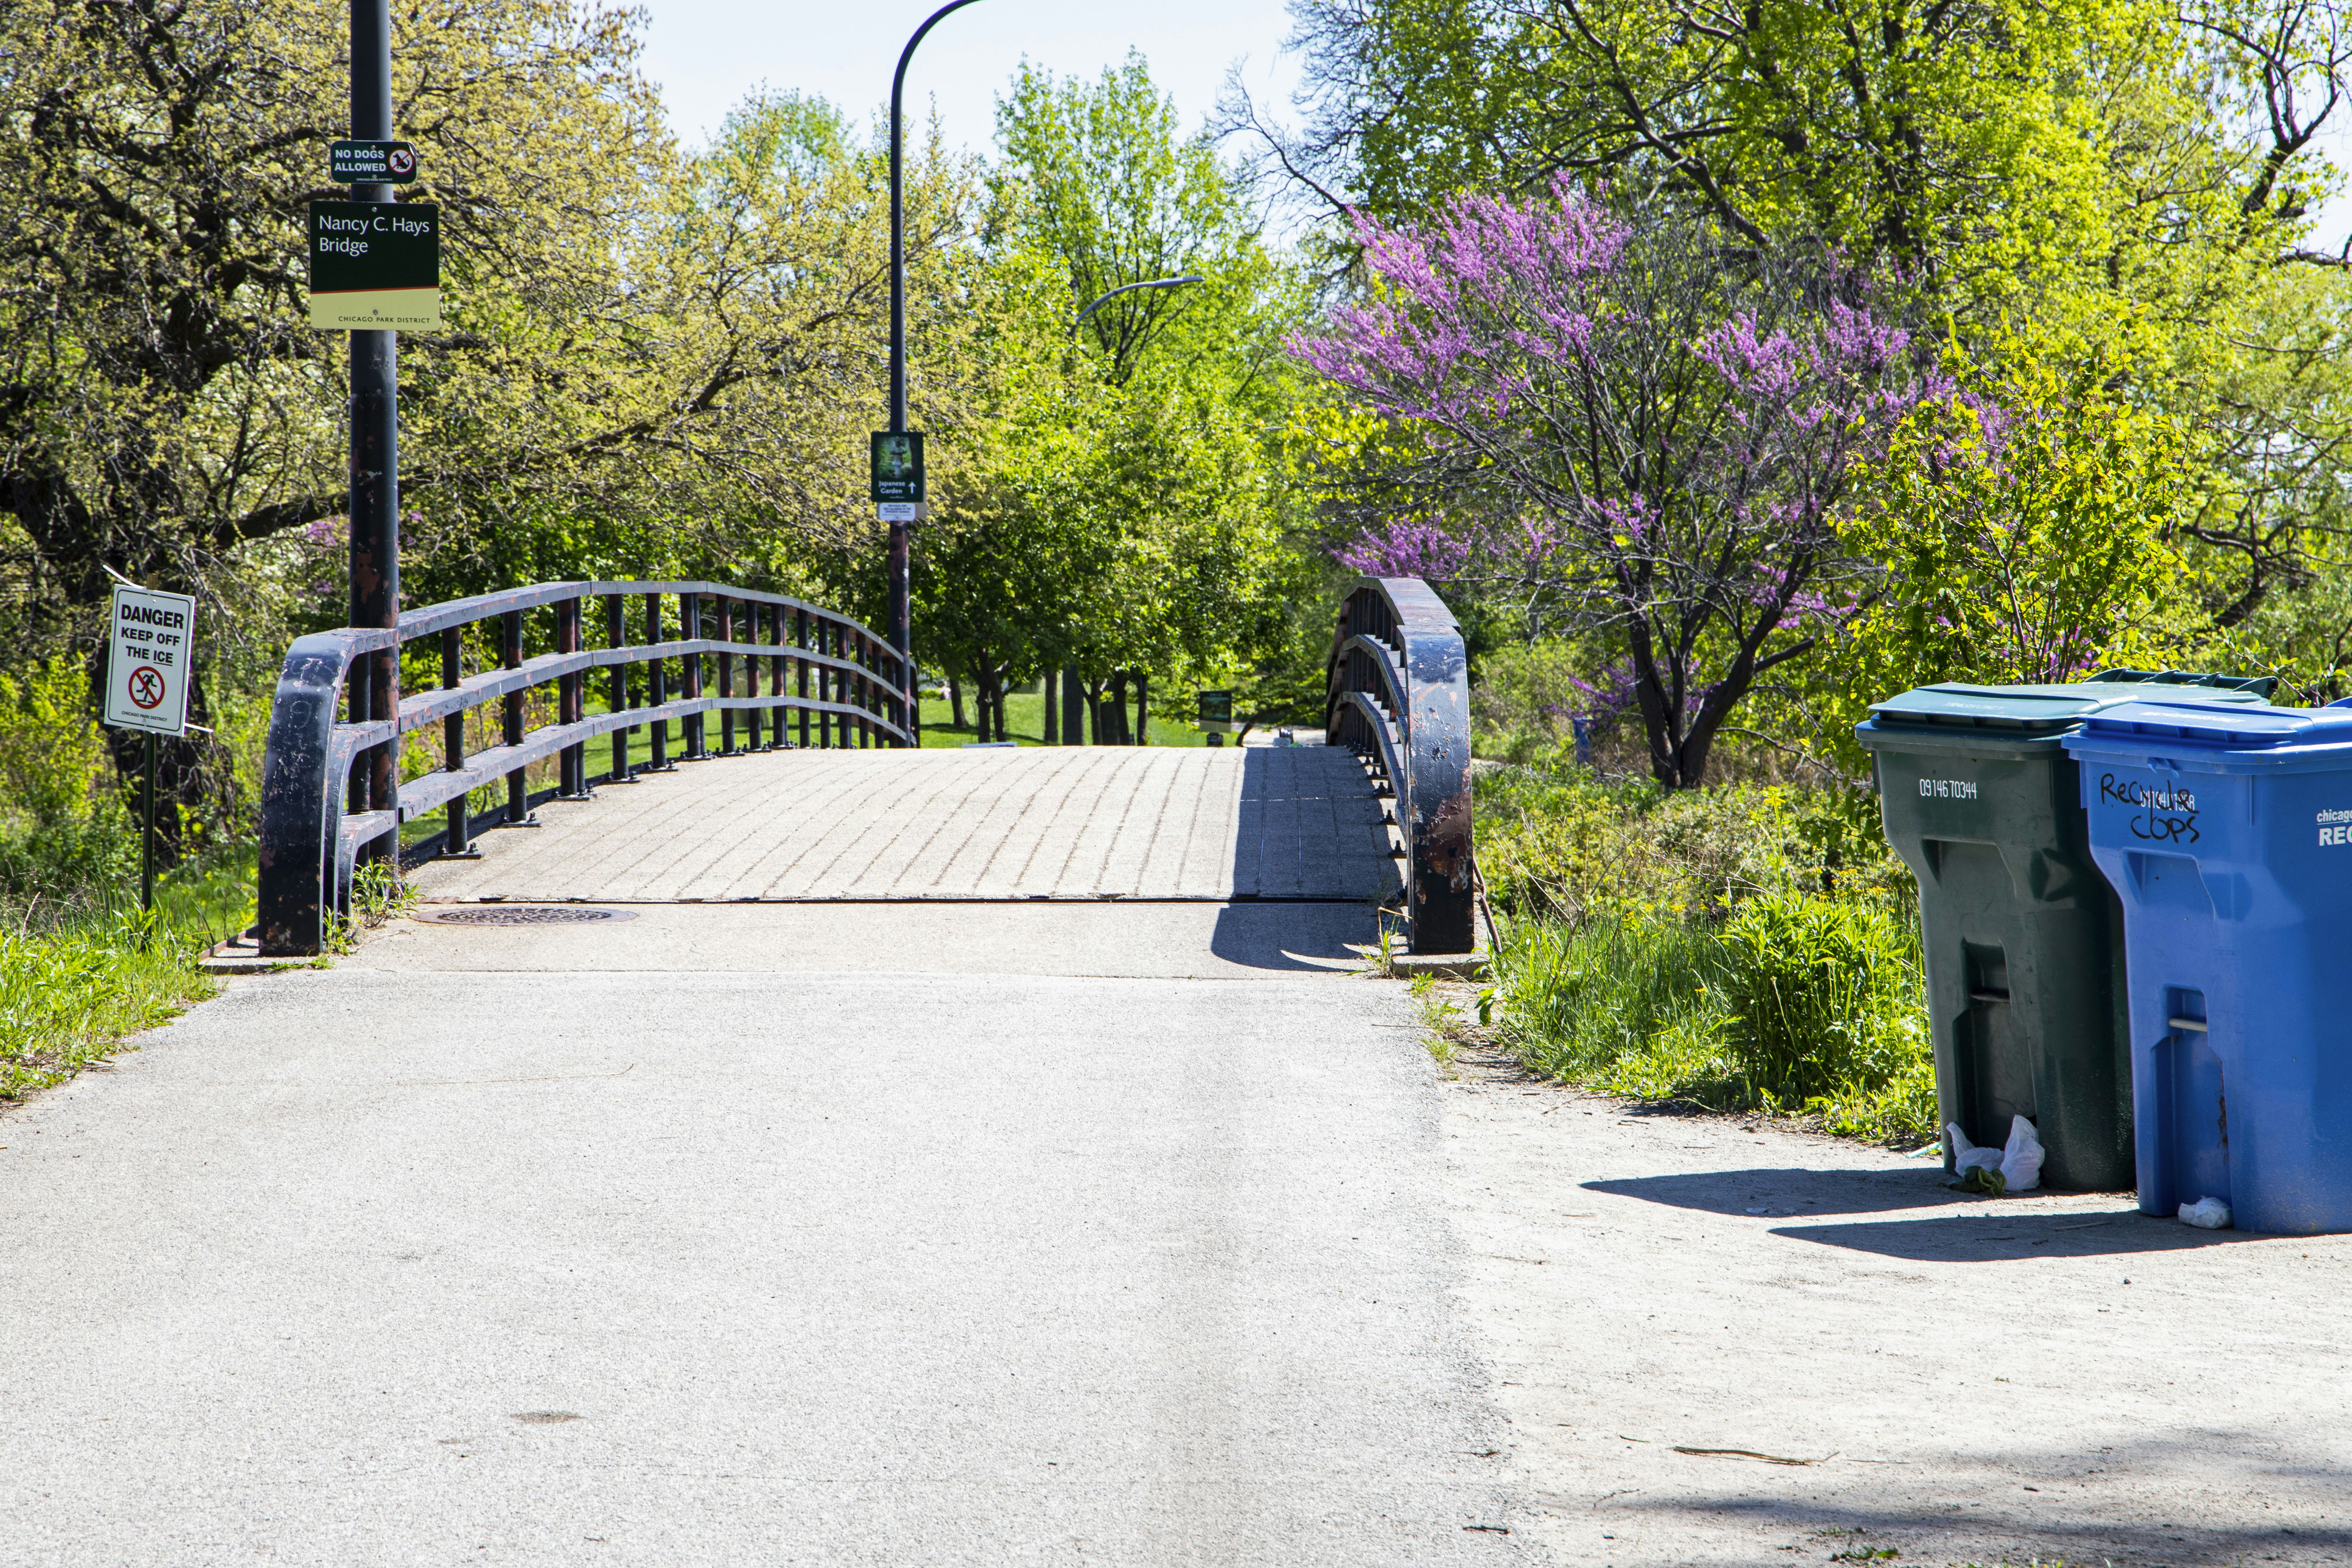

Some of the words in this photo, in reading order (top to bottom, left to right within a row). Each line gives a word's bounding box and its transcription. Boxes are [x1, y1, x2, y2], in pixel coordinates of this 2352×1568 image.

[335, 150, 351, 158] NO
[354, 150, 385, 159] DOGS
[335, 162, 386, 172] ALLOWED
[320, 215, 369, 235] Nancy
[373, 217, 388, 231] C.
[393, 217, 430, 236] Hays
[320, 237, 368, 257] Bridge
[121, 604, 184, 630] DANGER
[121, 627, 153, 642] KEEP
[156, 633, 180, 646] OFF
[126, 645, 150, 660] THE
[153, 650, 173, 663] ICE
